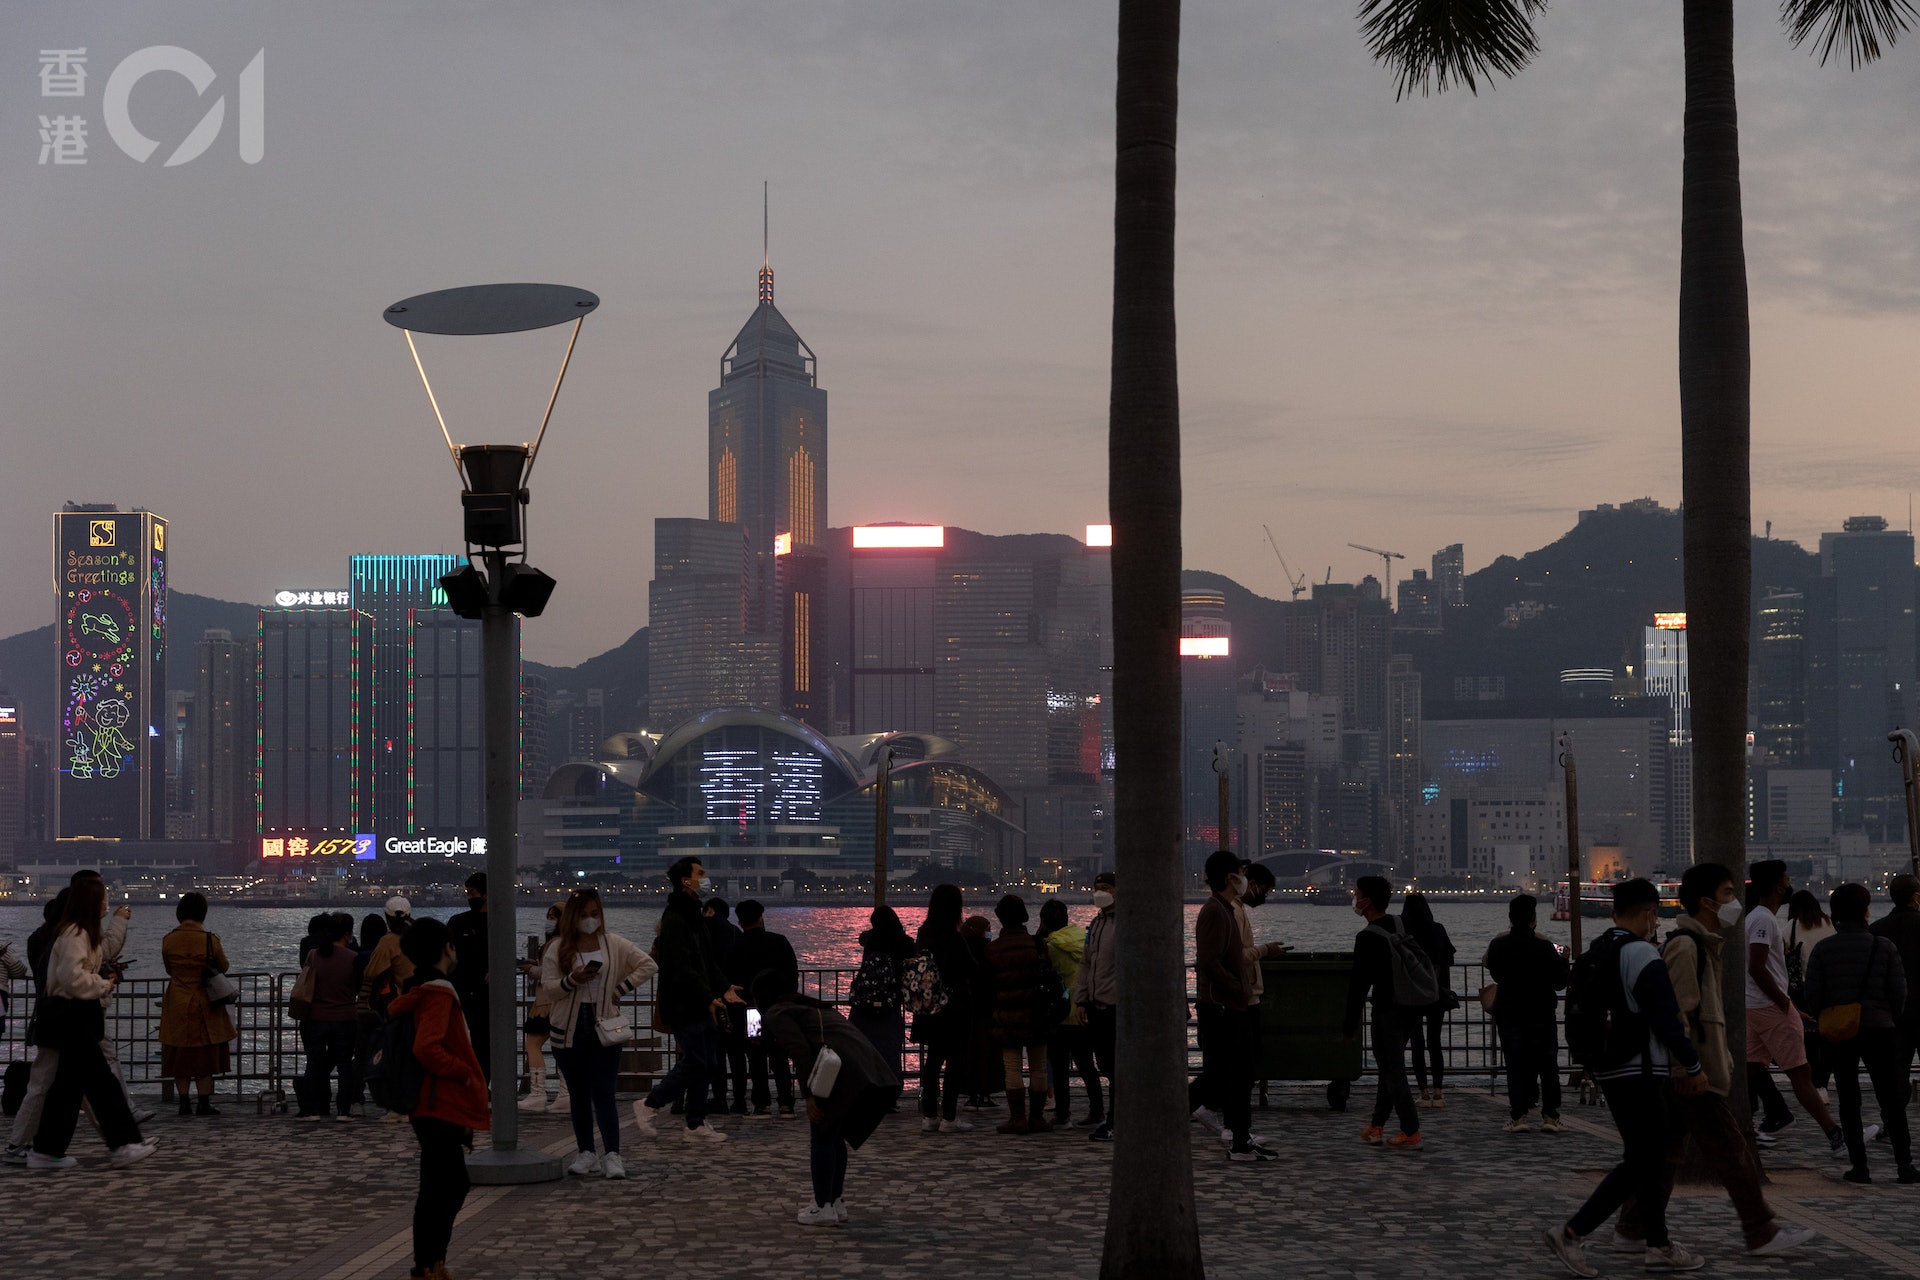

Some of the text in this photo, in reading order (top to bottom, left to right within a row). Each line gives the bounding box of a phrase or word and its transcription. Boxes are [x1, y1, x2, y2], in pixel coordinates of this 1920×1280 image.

[67, 568, 135, 585] Greetings
[297, 591, 349, 605] 兴业银行
[700, 751, 822, 820] 香港
[263, 836, 372, 857] 國窖 1573
[385, 836, 488, 857] Great Eagle 鷹
